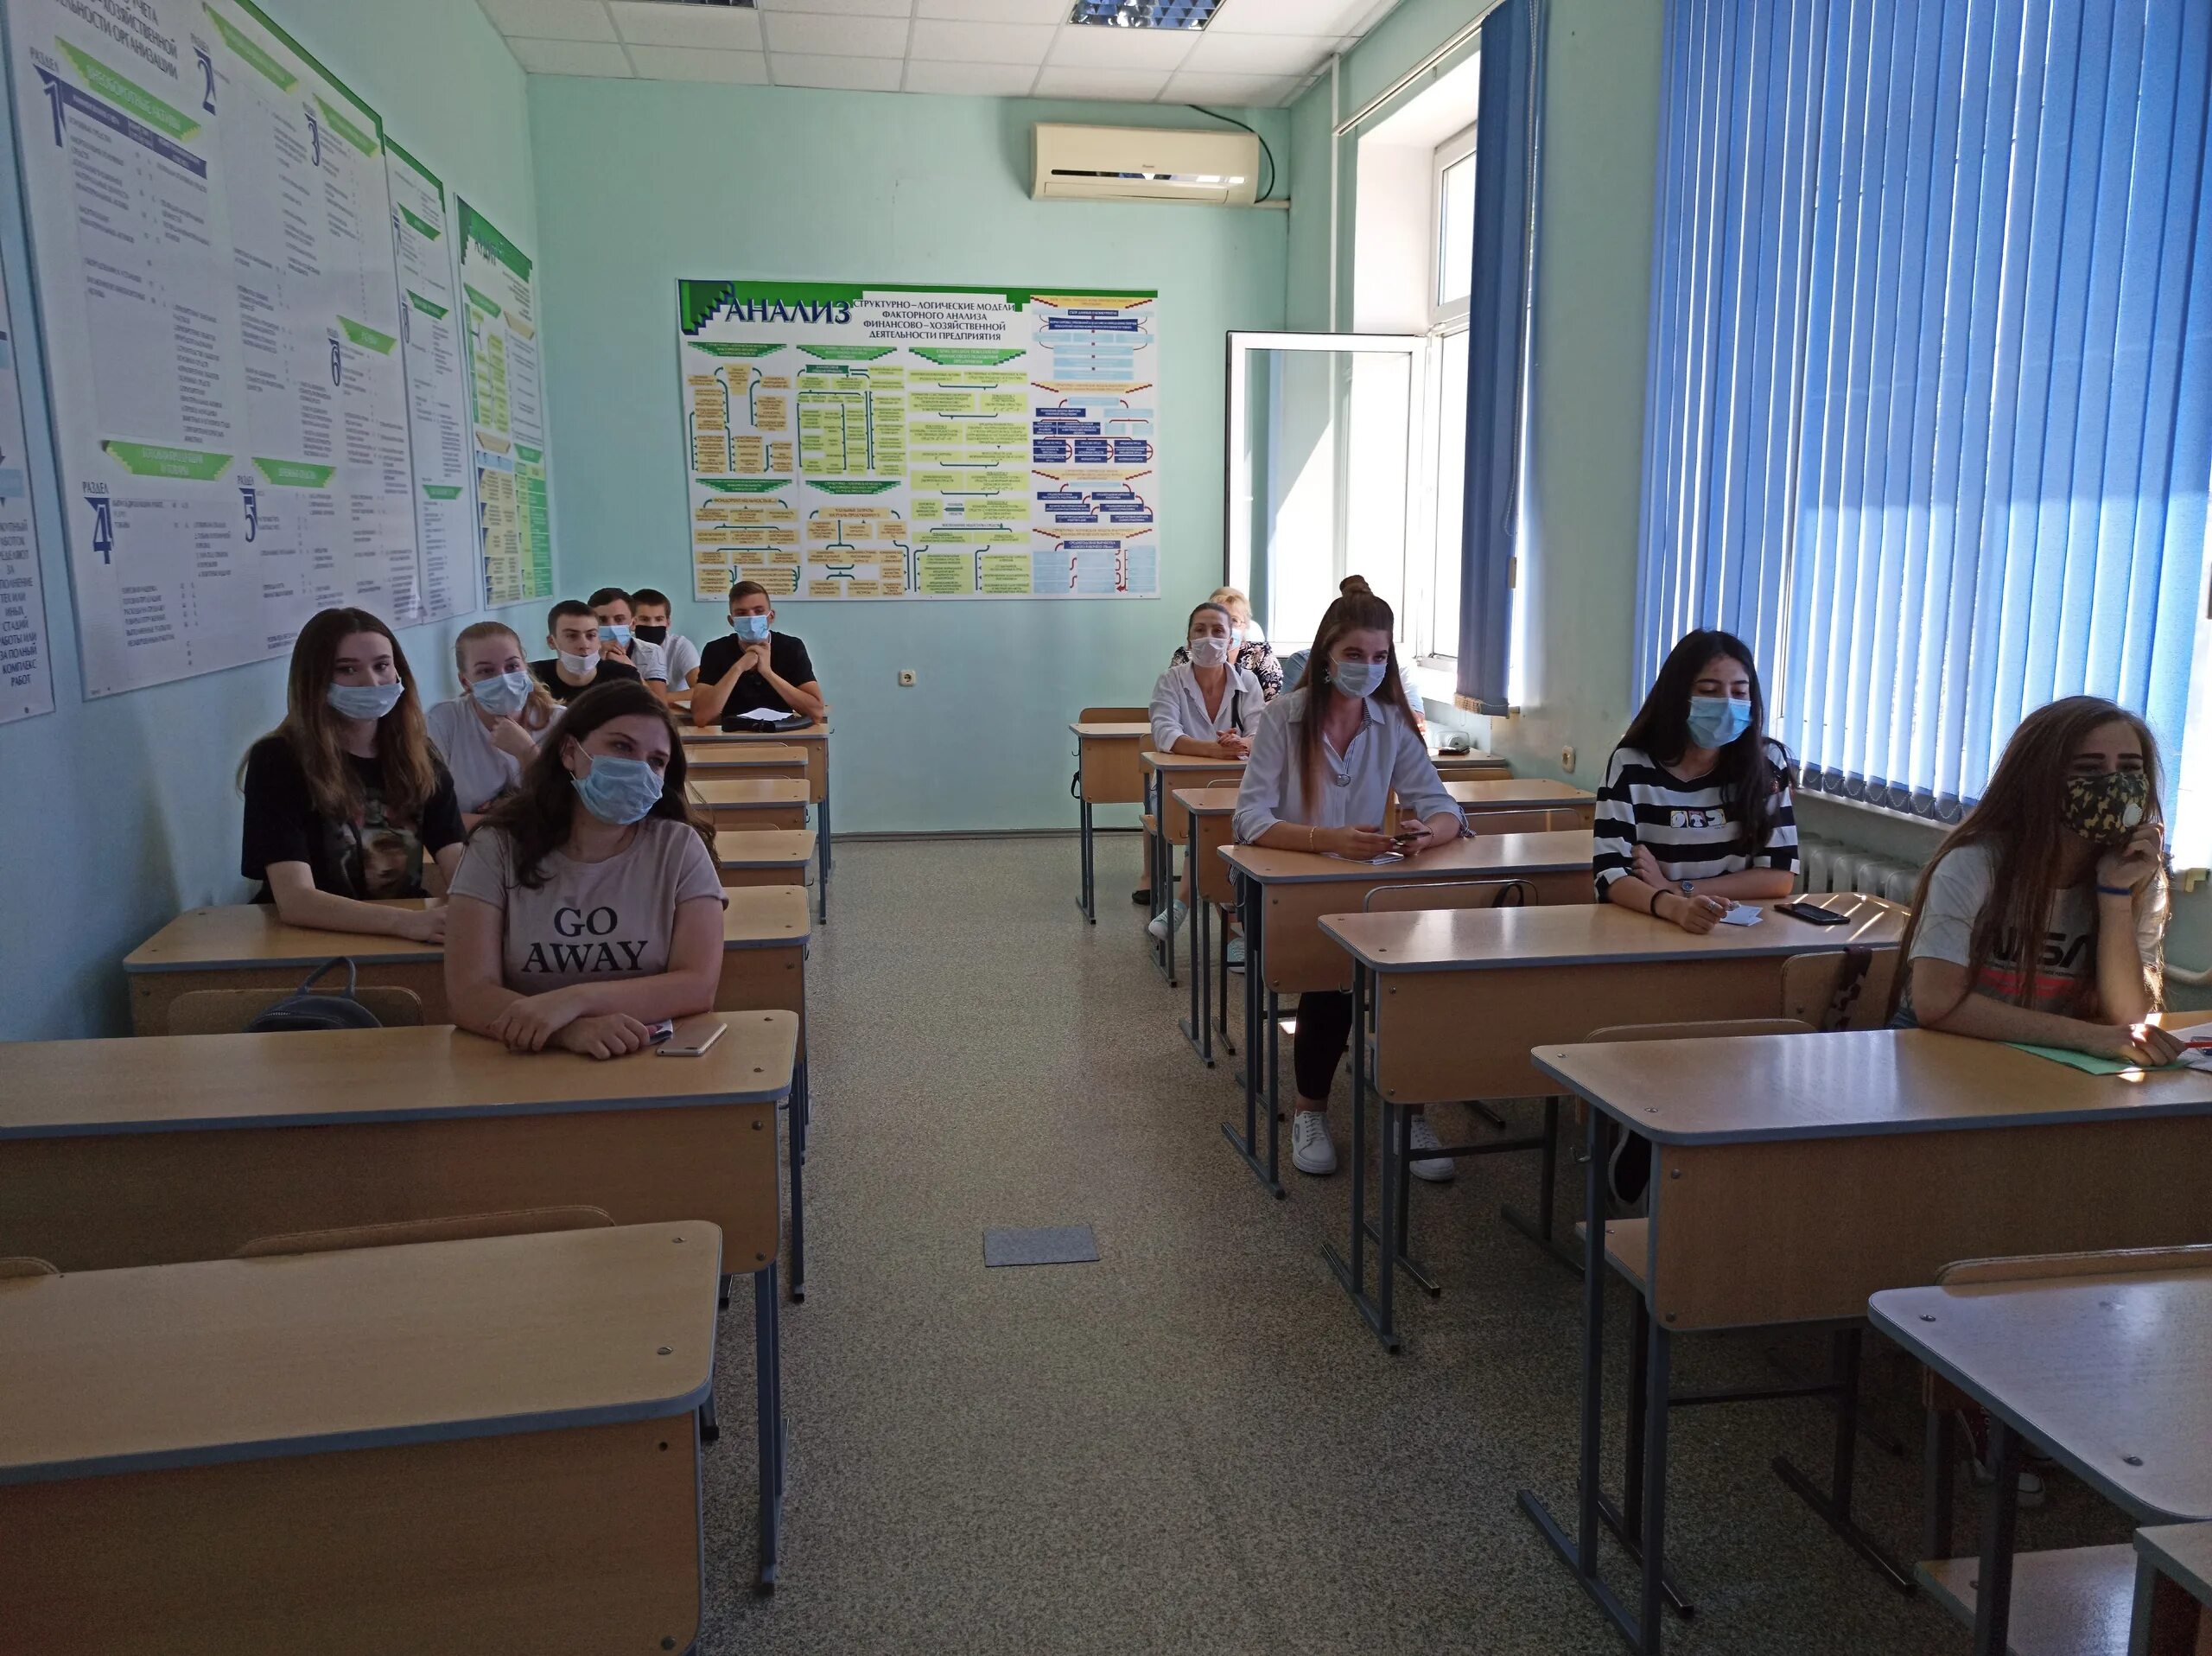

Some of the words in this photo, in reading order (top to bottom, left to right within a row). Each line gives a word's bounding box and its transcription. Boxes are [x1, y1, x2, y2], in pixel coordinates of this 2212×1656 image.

[55, 0, 113, 36] ЕЛЬНОСТИ
[112, 24, 178, 80] ОРГАНИЗАЦИИ
[197, 58, 216, 116] 2
[43, 81, 65, 148] 1
[308, 122, 321, 167] 3
[725, 297, 852, 325] АНАЛИЗ
[882, 310, 944, 320] ФАКТОРНОГО
[976, 302, 1015, 311] МОДЕЛИ
[869, 330, 938, 339] ДЕЯТЕЛЬНОСТИ
[939, 332, 1001, 341] ПРЕДПРИЯТИЯ
[332, 346, 341, 387] 6
[82, 481, 109, 494] РАЗДЕЛ
[244, 494, 257, 543] 5
[92, 506, 113, 564] 4
[3, 615, 29, 631] СТАДИЙ
[9, 642, 37, 659] ПОЛНЫЙ
[3, 659, 36, 674] КОМПЛЕКС
[10, 674, 30, 687] РАБОТ
[554, 907, 618, 937] GO
[521, 940, 648, 973] AWAY
